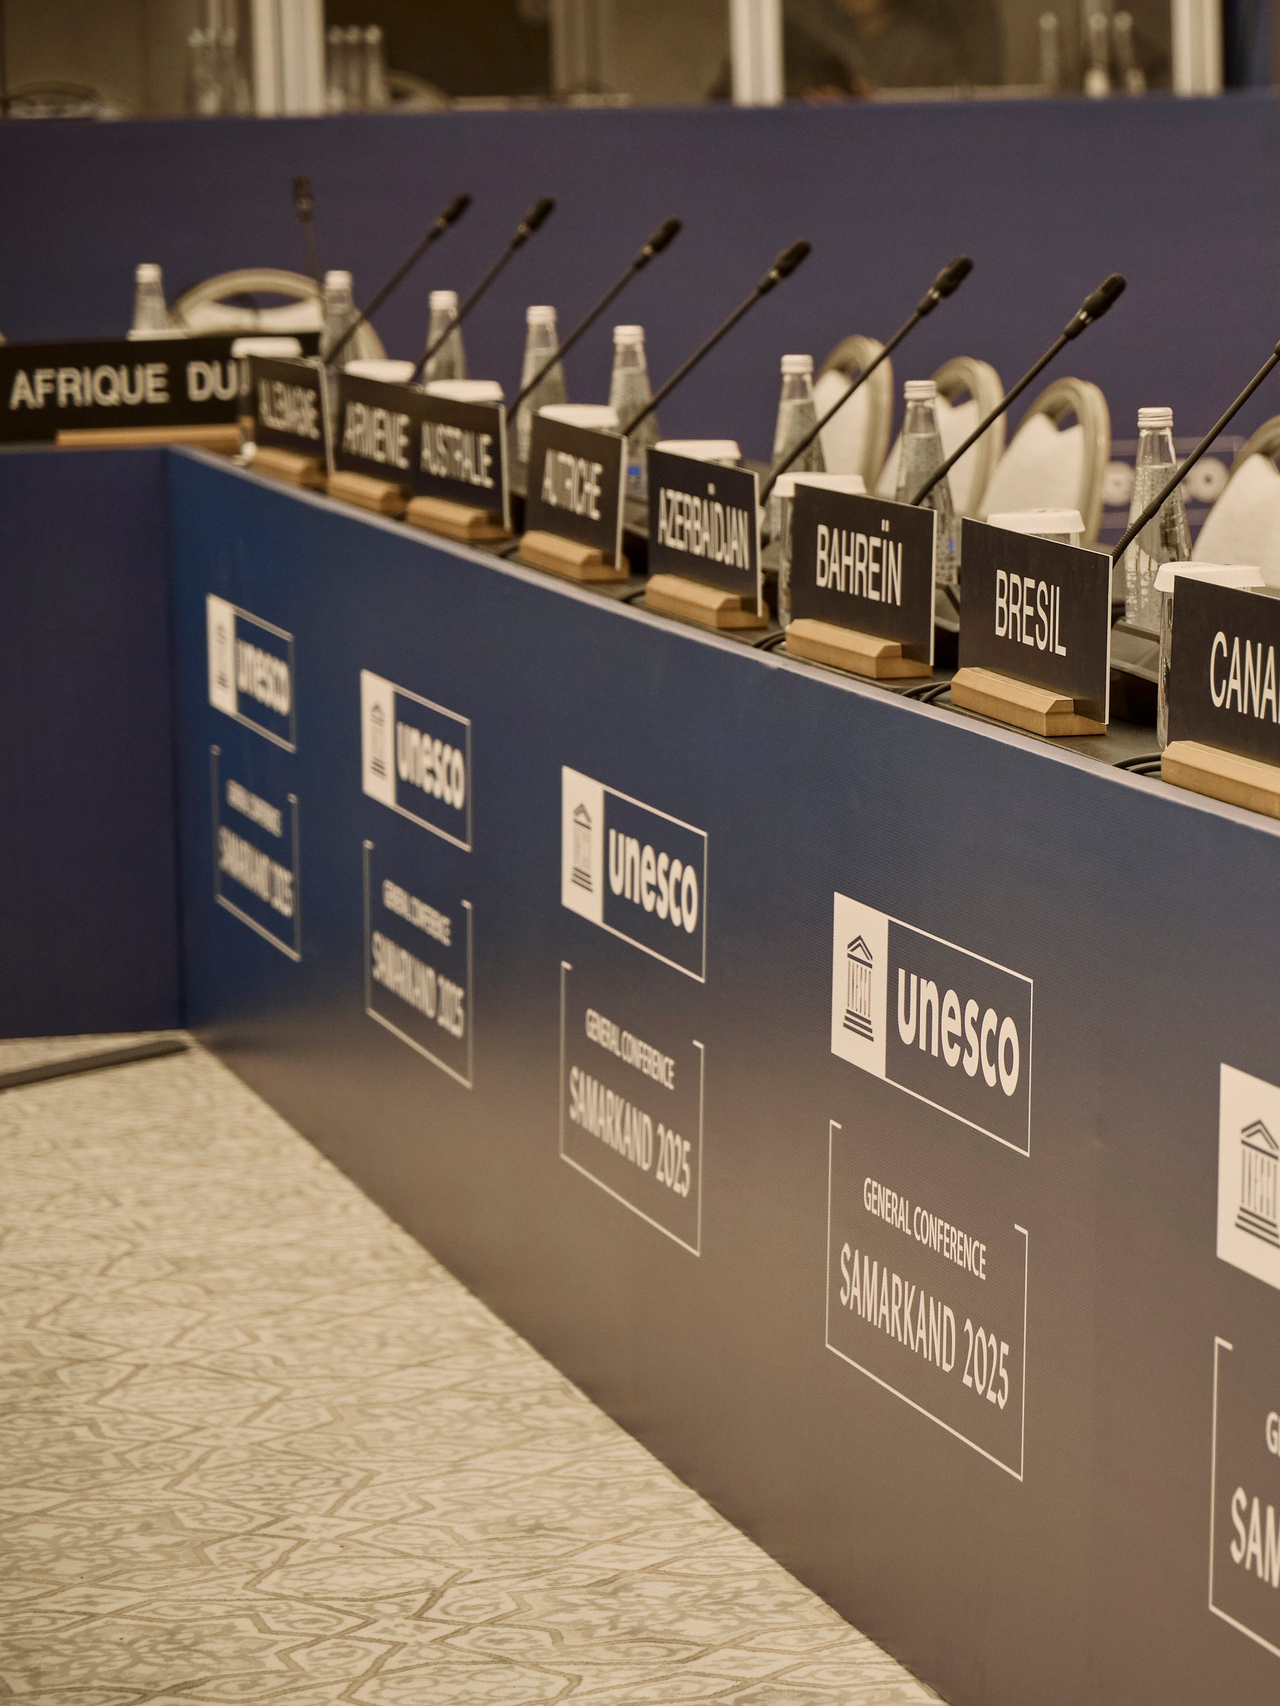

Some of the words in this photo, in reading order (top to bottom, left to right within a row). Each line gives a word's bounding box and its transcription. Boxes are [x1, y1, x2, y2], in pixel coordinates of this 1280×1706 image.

[9, 362, 170, 411] AFRIQUE
[187, 359, 238, 402] DU
[542, 448, 602, 521] AUTRICHE
[658, 482, 750, 570] AZERBAÏDJAN
[816, 519, 902, 606] BAHREÏN
[995, 569, 1067, 656] BRESIL
[236, 637, 291, 717] unesco
[397, 720, 465, 811] unesco
[608, 828, 699, 934] unesco
[585, 1008, 621, 1058] GENERAL
[621, 1030, 676, 1090] CONFERENCE
[897, 967, 1020, 1096] unesco
[569, 1065, 653, 1171] SAMARKAND
[655, 1122, 691, 1198] 2025
[864, 1177, 911, 1235] GENERAL
[914, 1206, 987, 1280] CONFERENCE
[839, 1242, 956, 1374] SAMARKAND
[963, 1318, 1010, 1410] 2025
